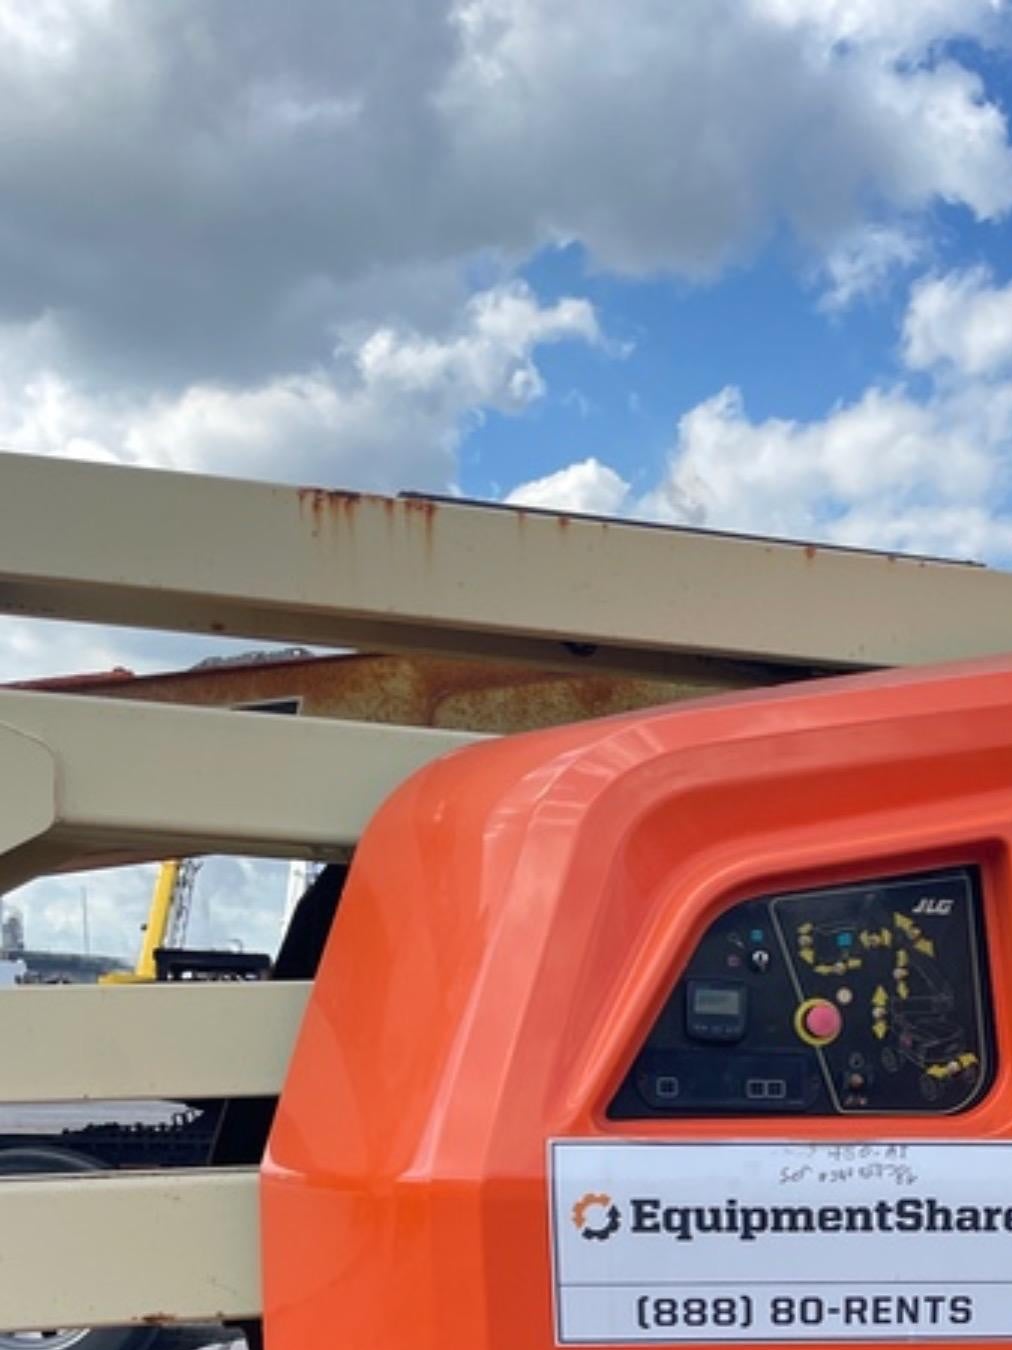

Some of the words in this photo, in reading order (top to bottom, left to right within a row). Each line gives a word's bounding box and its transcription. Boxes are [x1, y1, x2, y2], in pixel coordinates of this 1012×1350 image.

[911, 897, 954, 915] JLG
[637, 1295, 753, 1329] (888)
[770, 1295, 974, 1325] 80-RENTS
